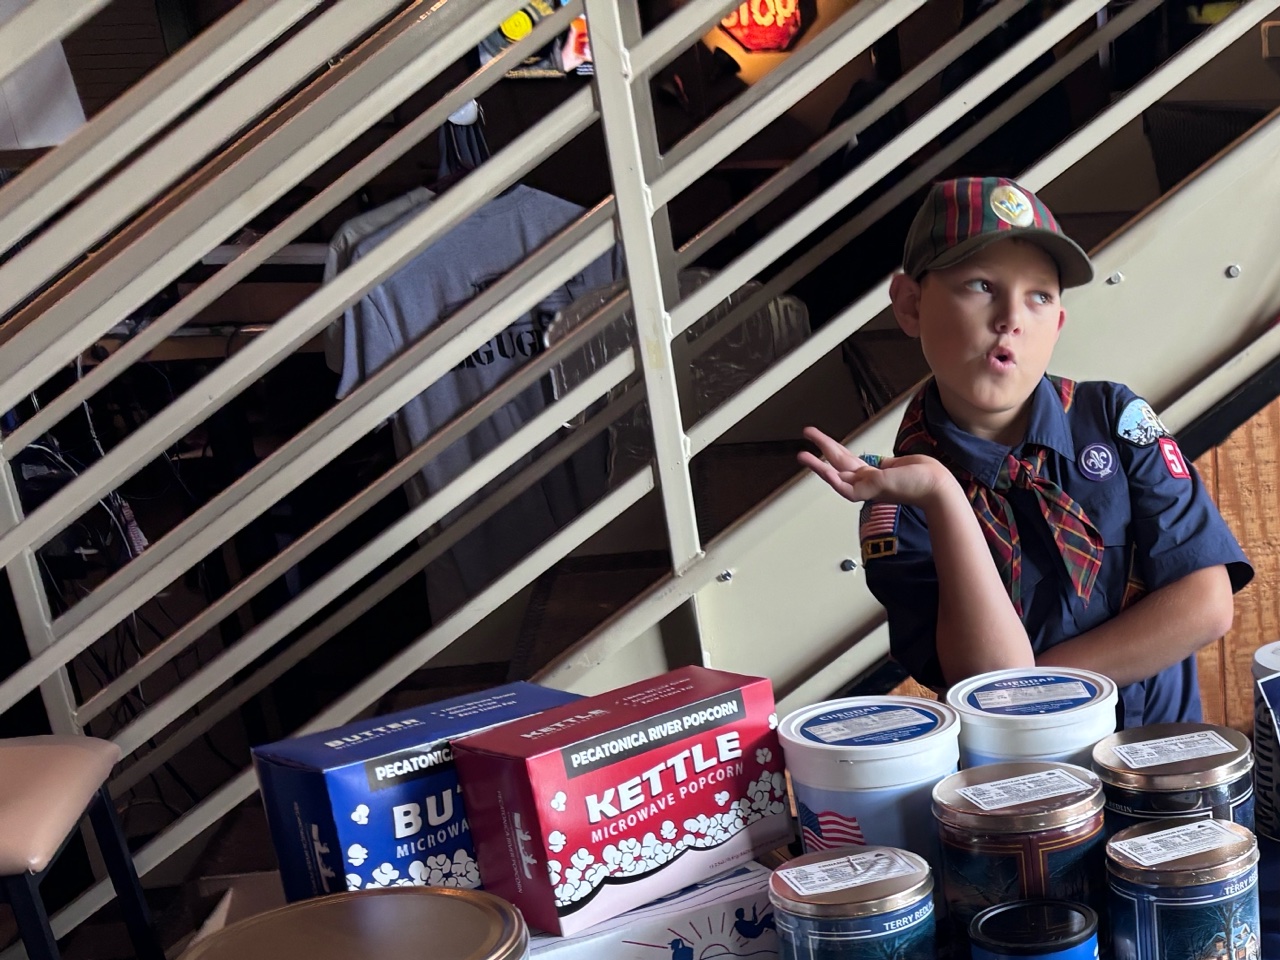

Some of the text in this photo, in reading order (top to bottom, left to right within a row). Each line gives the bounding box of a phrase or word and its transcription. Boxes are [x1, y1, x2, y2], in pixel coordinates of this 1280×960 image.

[994, 676, 1056, 688] CHEDDAR
[520, 708, 606, 739] KETTLE
[818, 706, 881, 722] CHEDDAR
[324, 718, 419, 748] BUTTER
[571, 700, 739, 768] PECATONICA RIVER POPCORN
[375, 749, 454, 781] PECATONIC
[586, 731, 742, 824] KETTLE
[393, 785, 463, 839] BU
[591, 762, 743, 843] MICROWAVE POPCORN
[1223, 880, 1248, 896] TERRY
[883, 914, 914, 931] TERRY
